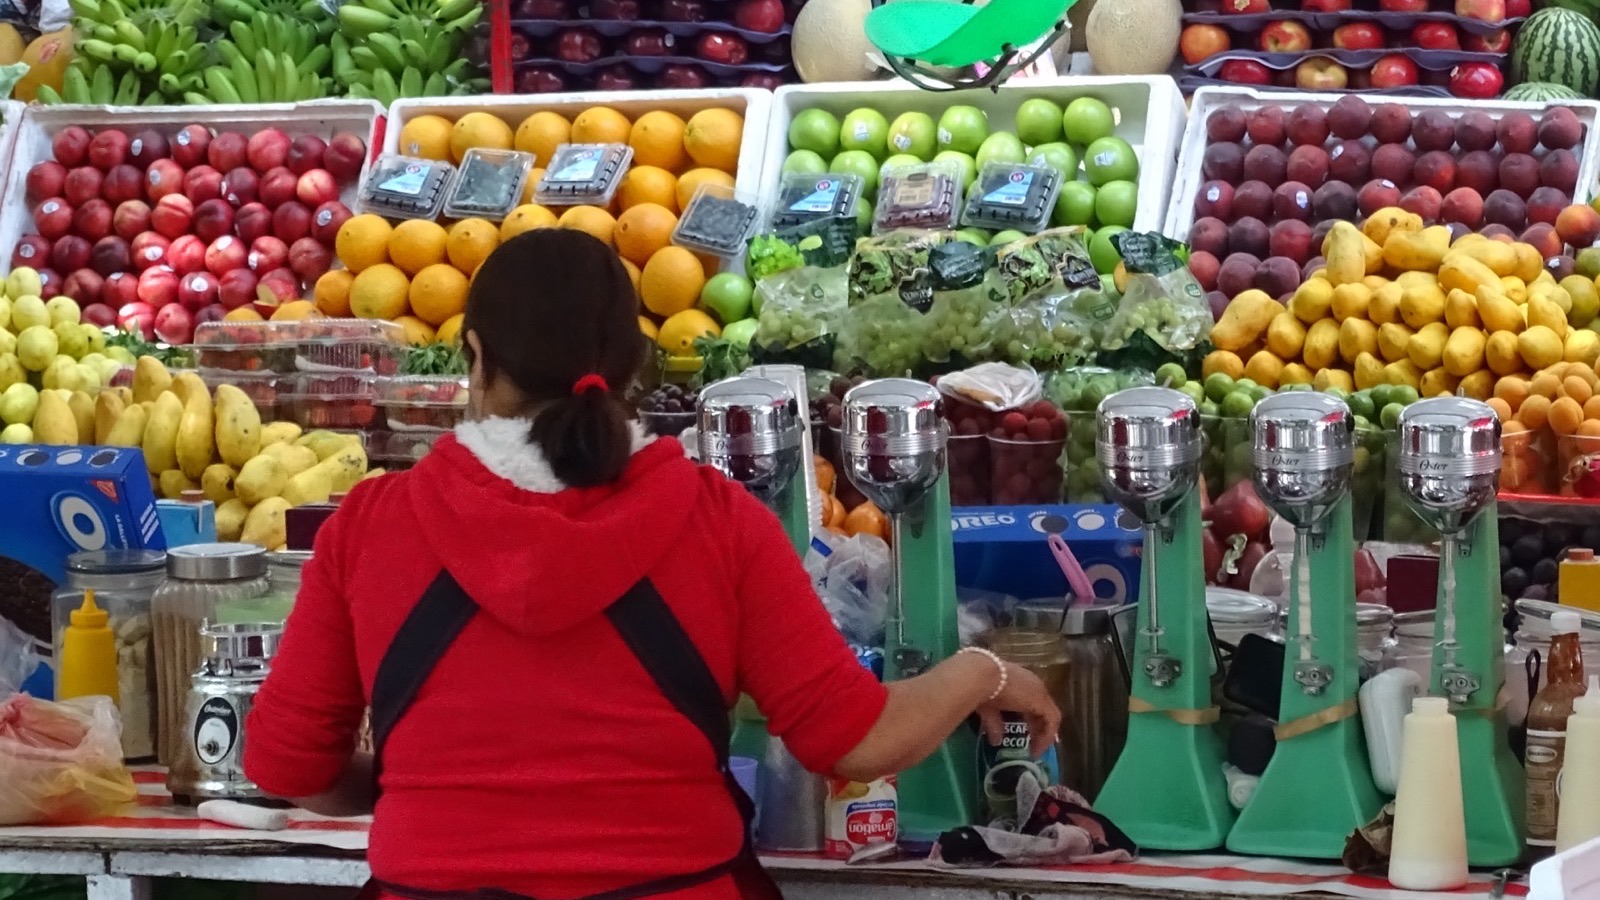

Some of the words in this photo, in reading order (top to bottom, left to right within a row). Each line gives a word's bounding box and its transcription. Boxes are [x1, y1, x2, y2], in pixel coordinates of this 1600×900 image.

[1116, 450, 1144, 463] Oster
[1271, 455, 1300, 467] Oster
[1419, 458, 1448, 471] Oster
[1002, 733, 1031, 750] ecaf
